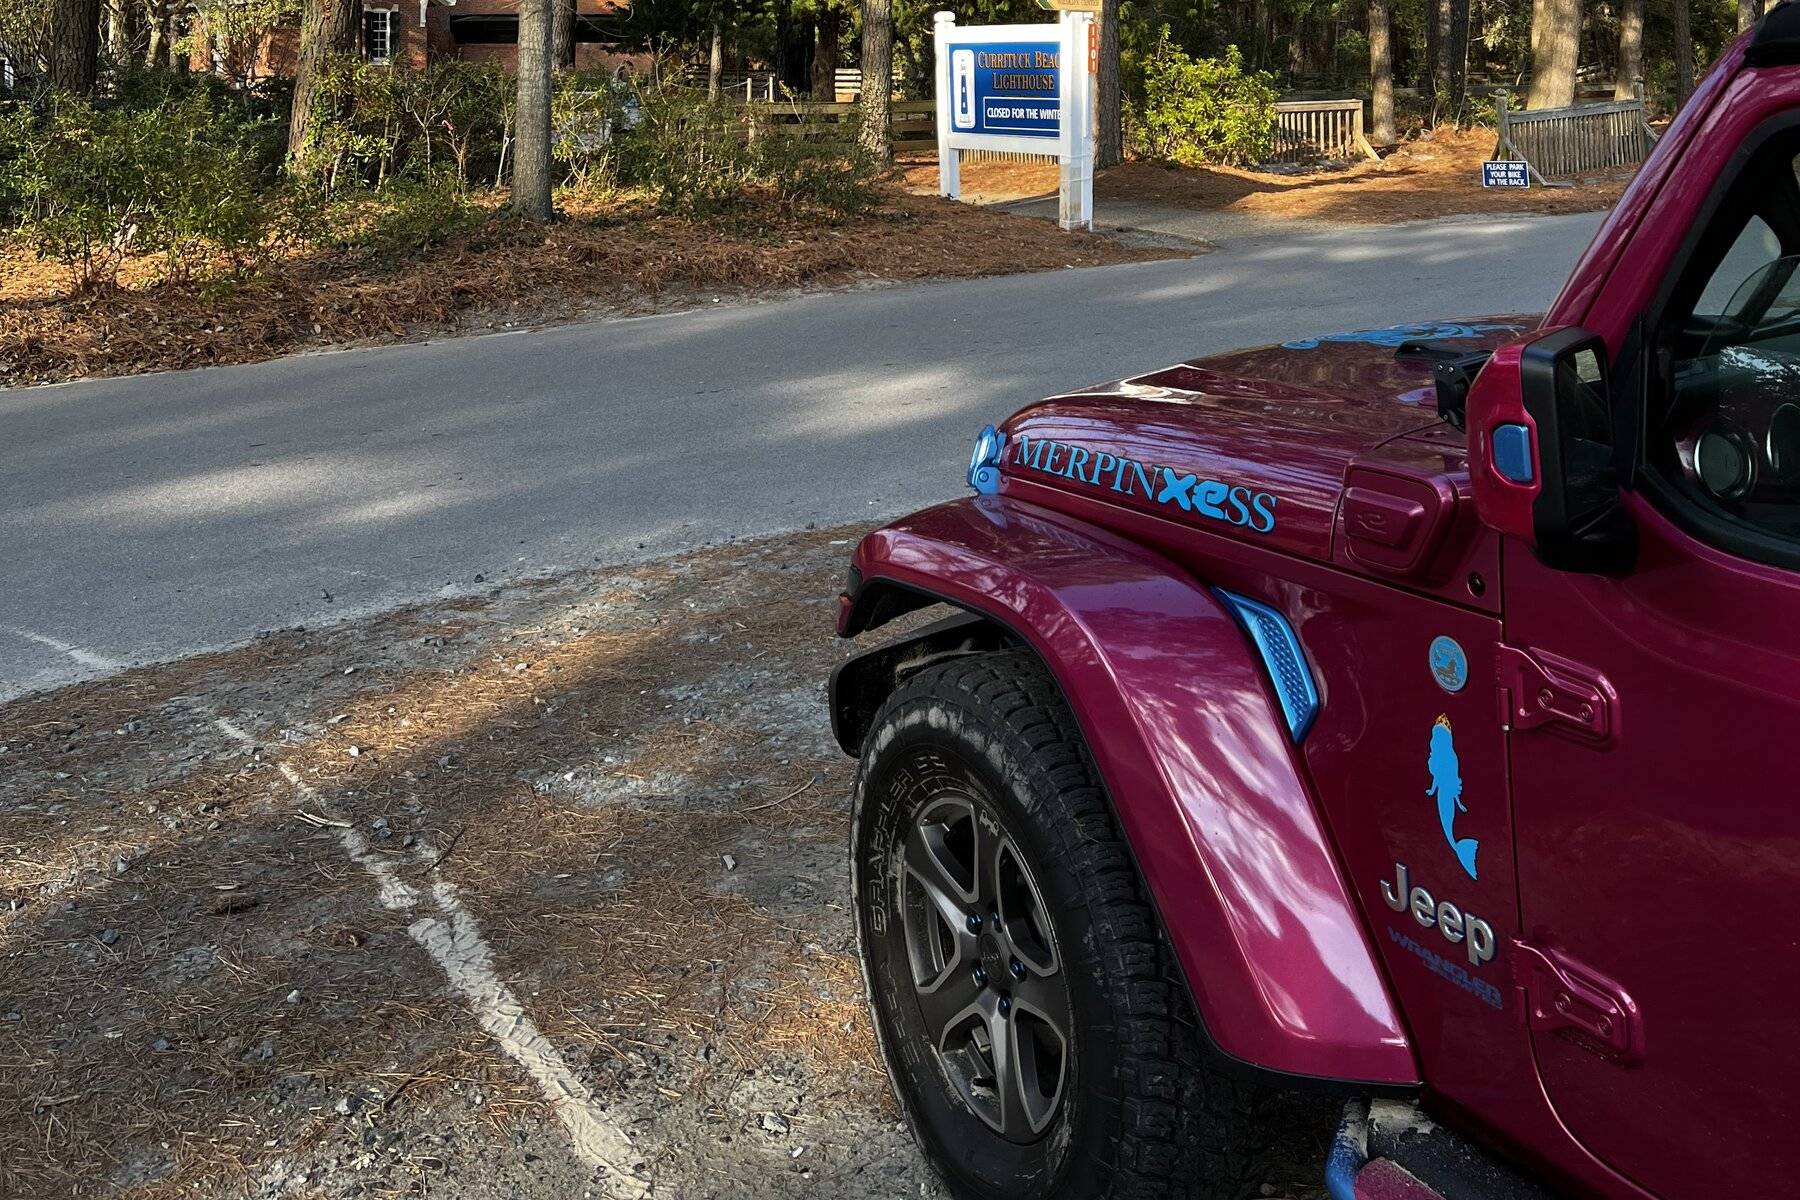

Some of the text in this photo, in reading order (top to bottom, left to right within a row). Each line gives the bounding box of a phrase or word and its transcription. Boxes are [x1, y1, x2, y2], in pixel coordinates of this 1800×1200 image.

[977, 50, 1061, 69] CURRITUCK BEAC
[992, 72, 1055, 90] LIGHTHOUSE
[986, 107, 1061, 120] CLOSED FOR THE WINTE
[1488, 178, 1496, 186] IN
[1380, 862, 1496, 967] Jeep
